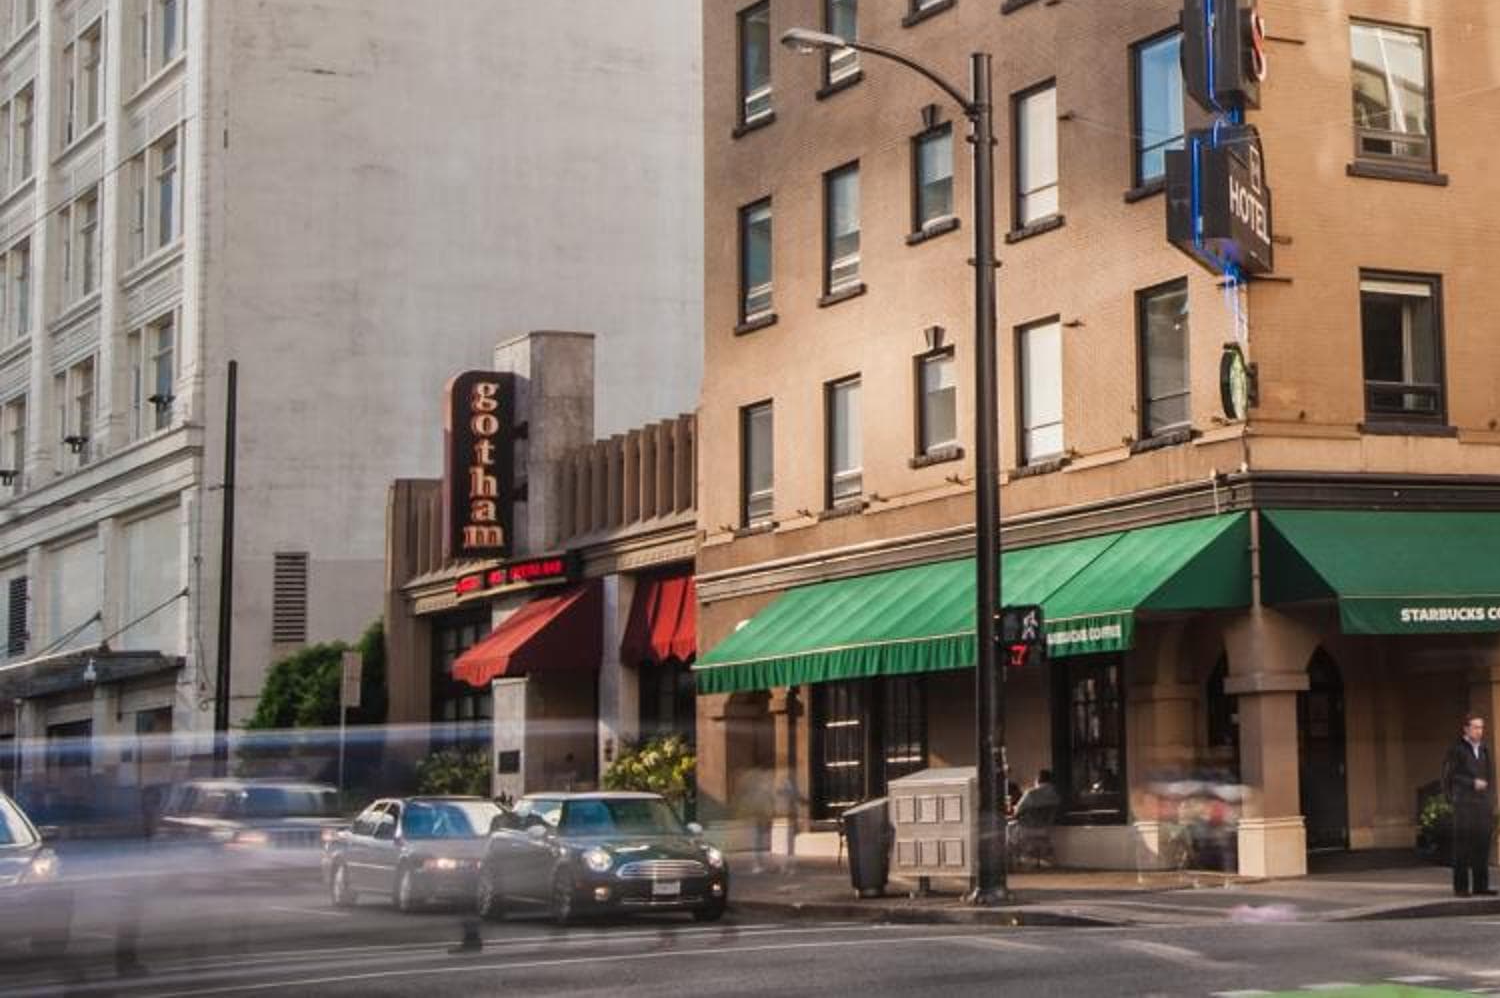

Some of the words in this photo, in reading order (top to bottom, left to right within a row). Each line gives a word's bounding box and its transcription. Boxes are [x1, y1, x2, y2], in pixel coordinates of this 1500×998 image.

[1228, 175, 1270, 245] HOTEL
[463, 382, 503, 548] gotham
[1401, 607, 1485, 622] STARBUCKS
